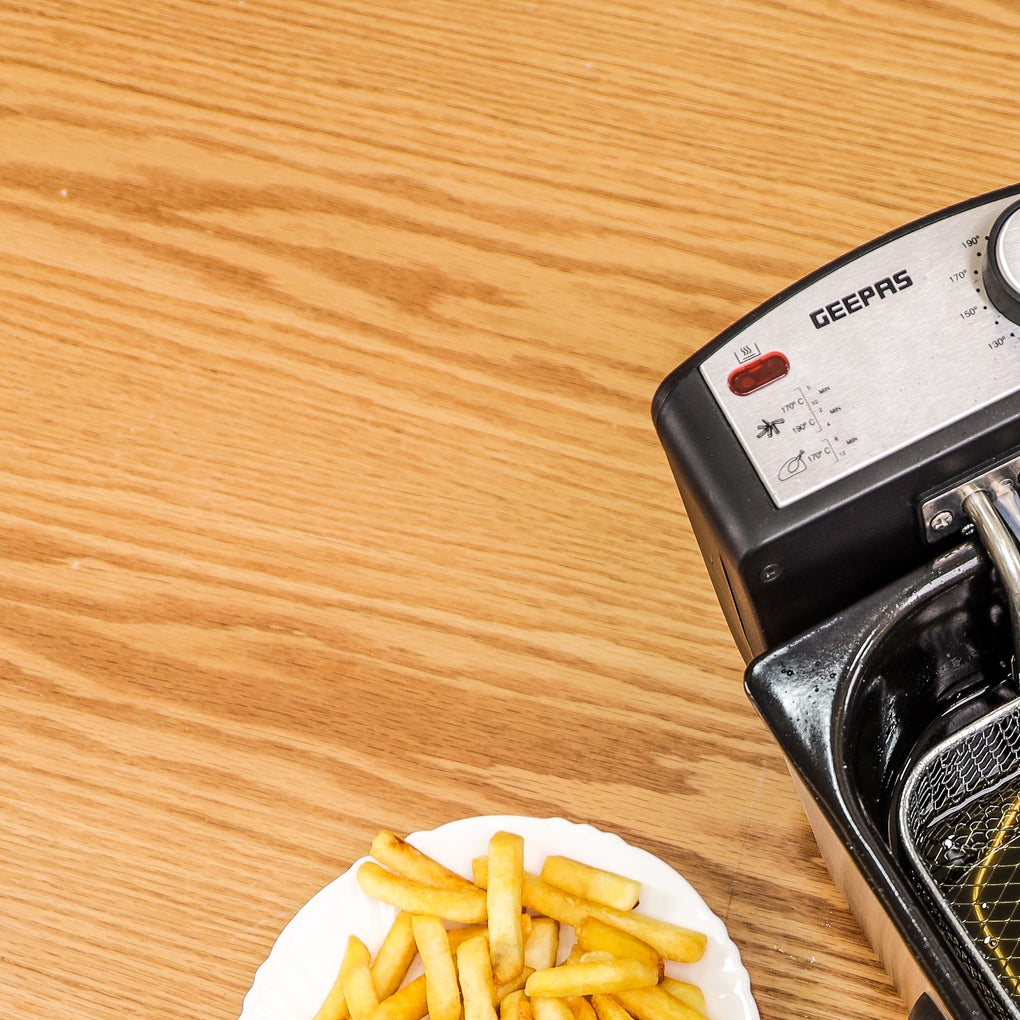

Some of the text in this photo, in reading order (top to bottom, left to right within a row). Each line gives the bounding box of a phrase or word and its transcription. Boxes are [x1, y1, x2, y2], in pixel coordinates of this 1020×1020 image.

[962, 235, 980, 249] 190°
[949, 269, 967, 283] 170°
[809, 269, 913, 329] GEEPAS
[960, 306, 977, 320] 150°
[988, 336, 1006, 350] 130°
